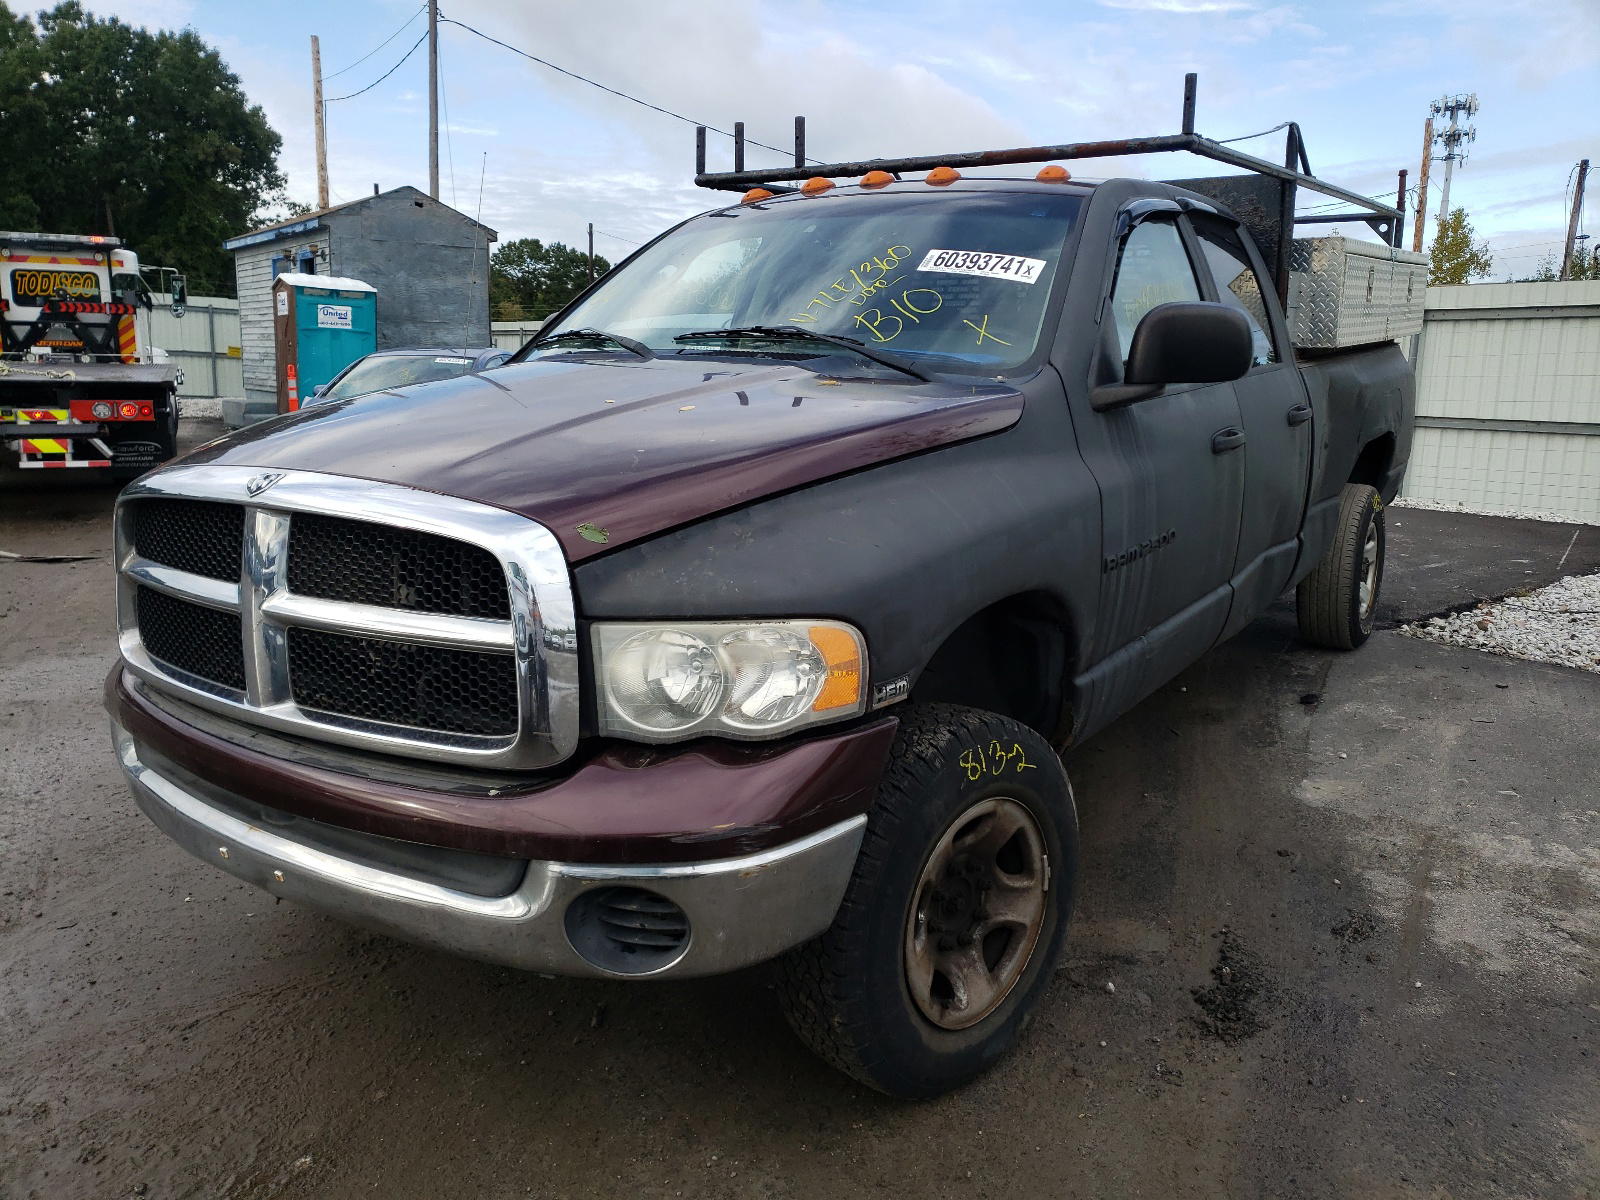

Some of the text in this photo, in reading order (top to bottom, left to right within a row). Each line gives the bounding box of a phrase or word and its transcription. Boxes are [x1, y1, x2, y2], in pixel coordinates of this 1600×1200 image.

[934, 251, 1026, 276] 60393741
[15, 271, 96, 298] TODISCO
[322, 309, 348, 317] United
